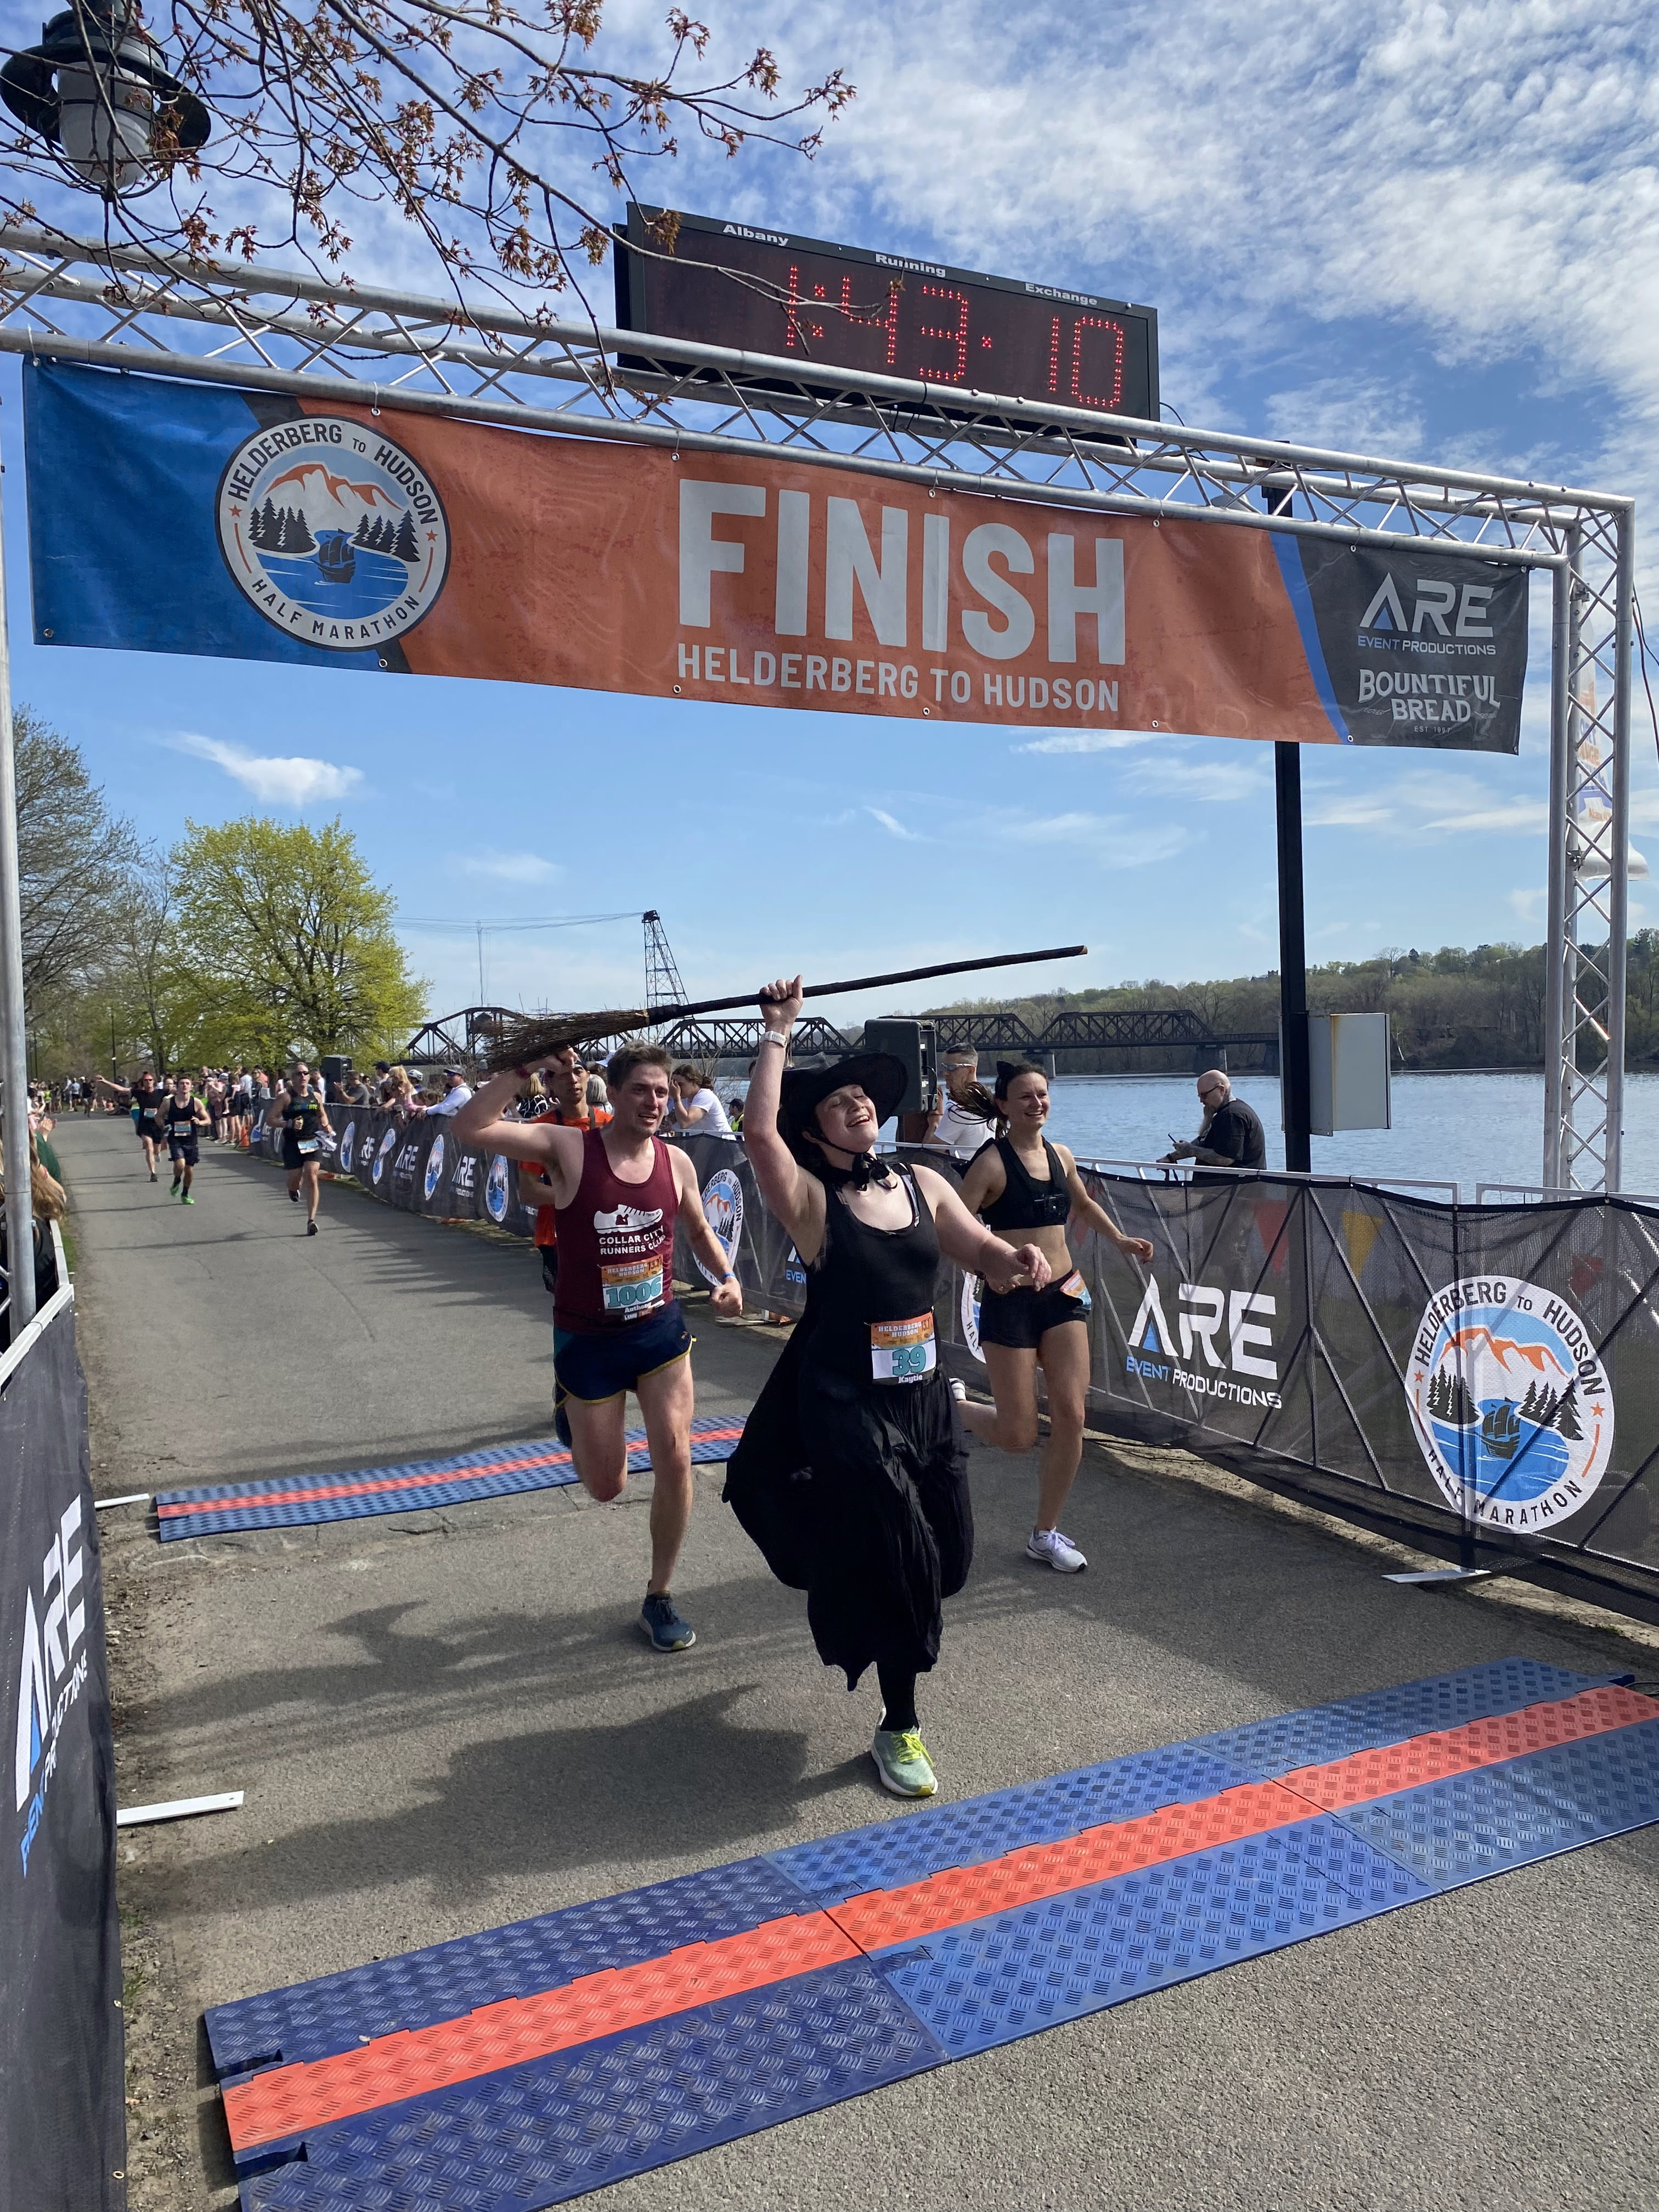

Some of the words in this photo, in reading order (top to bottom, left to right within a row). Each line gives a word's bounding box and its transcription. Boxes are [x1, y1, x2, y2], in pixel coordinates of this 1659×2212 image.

[723, 223, 789, 247] Albany
[876, 253, 947, 278] Running
[1025, 282, 1098, 306] Exchange
[228, 424, 342, 501] HELDERBERG
[352, 438, 366, 453] TO
[374, 445, 438, 524] HUDSON
[679, 478, 1125, 665] FINISH
[252, 579, 302, 624] HALF
[312, 595, 420, 640] MARATHON
[1359, 572, 1494, 637] ARE
[1358, 635, 1400, 651] EVENT
[1402, 640, 1496, 655] PRODUCTIONS
[678, 642, 918, 698] HELDERBERG
[930, 668, 971, 703] TO
[984, 673, 1119, 712] HUDSON
[1358, 669, 1501, 709] BOUNTIFUL
[1391, 698, 1471, 723] BREAD
[360, 1136, 375, 1160] RE
[452, 1153, 477, 1188] ARE
[702, 1172, 727, 1202] LDERBERG
[732, 1180, 742, 1222] HUDSON
[599, 1235, 641, 1244] COLLAR
[644, 1225, 664, 1241] CITY
[600, 1245, 646, 1255] RUNNERS
[648, 1234, 665, 1250] CLUB
[606, 1277, 662, 1308] 1006
[786, 1269, 807, 1284] EVEN
[891, 1328, 919, 1338] HUDSON
[1128, 1273, 1278, 1380] ARE
[1414, 1282, 1506, 1367] HELDERBERG
[1517, 1296, 1533, 1311] TO
[1543, 1300, 1606, 1397] HUDSON
[892, 1346, 926, 1376] 39
[1126, 1356, 1171, 1381] EVENT
[1172, 1368, 1282, 1409] PRODUCTIONS
[1474, 1480, 1583, 1525] MARATHON
[15, 1493, 86, 1813] ARE
